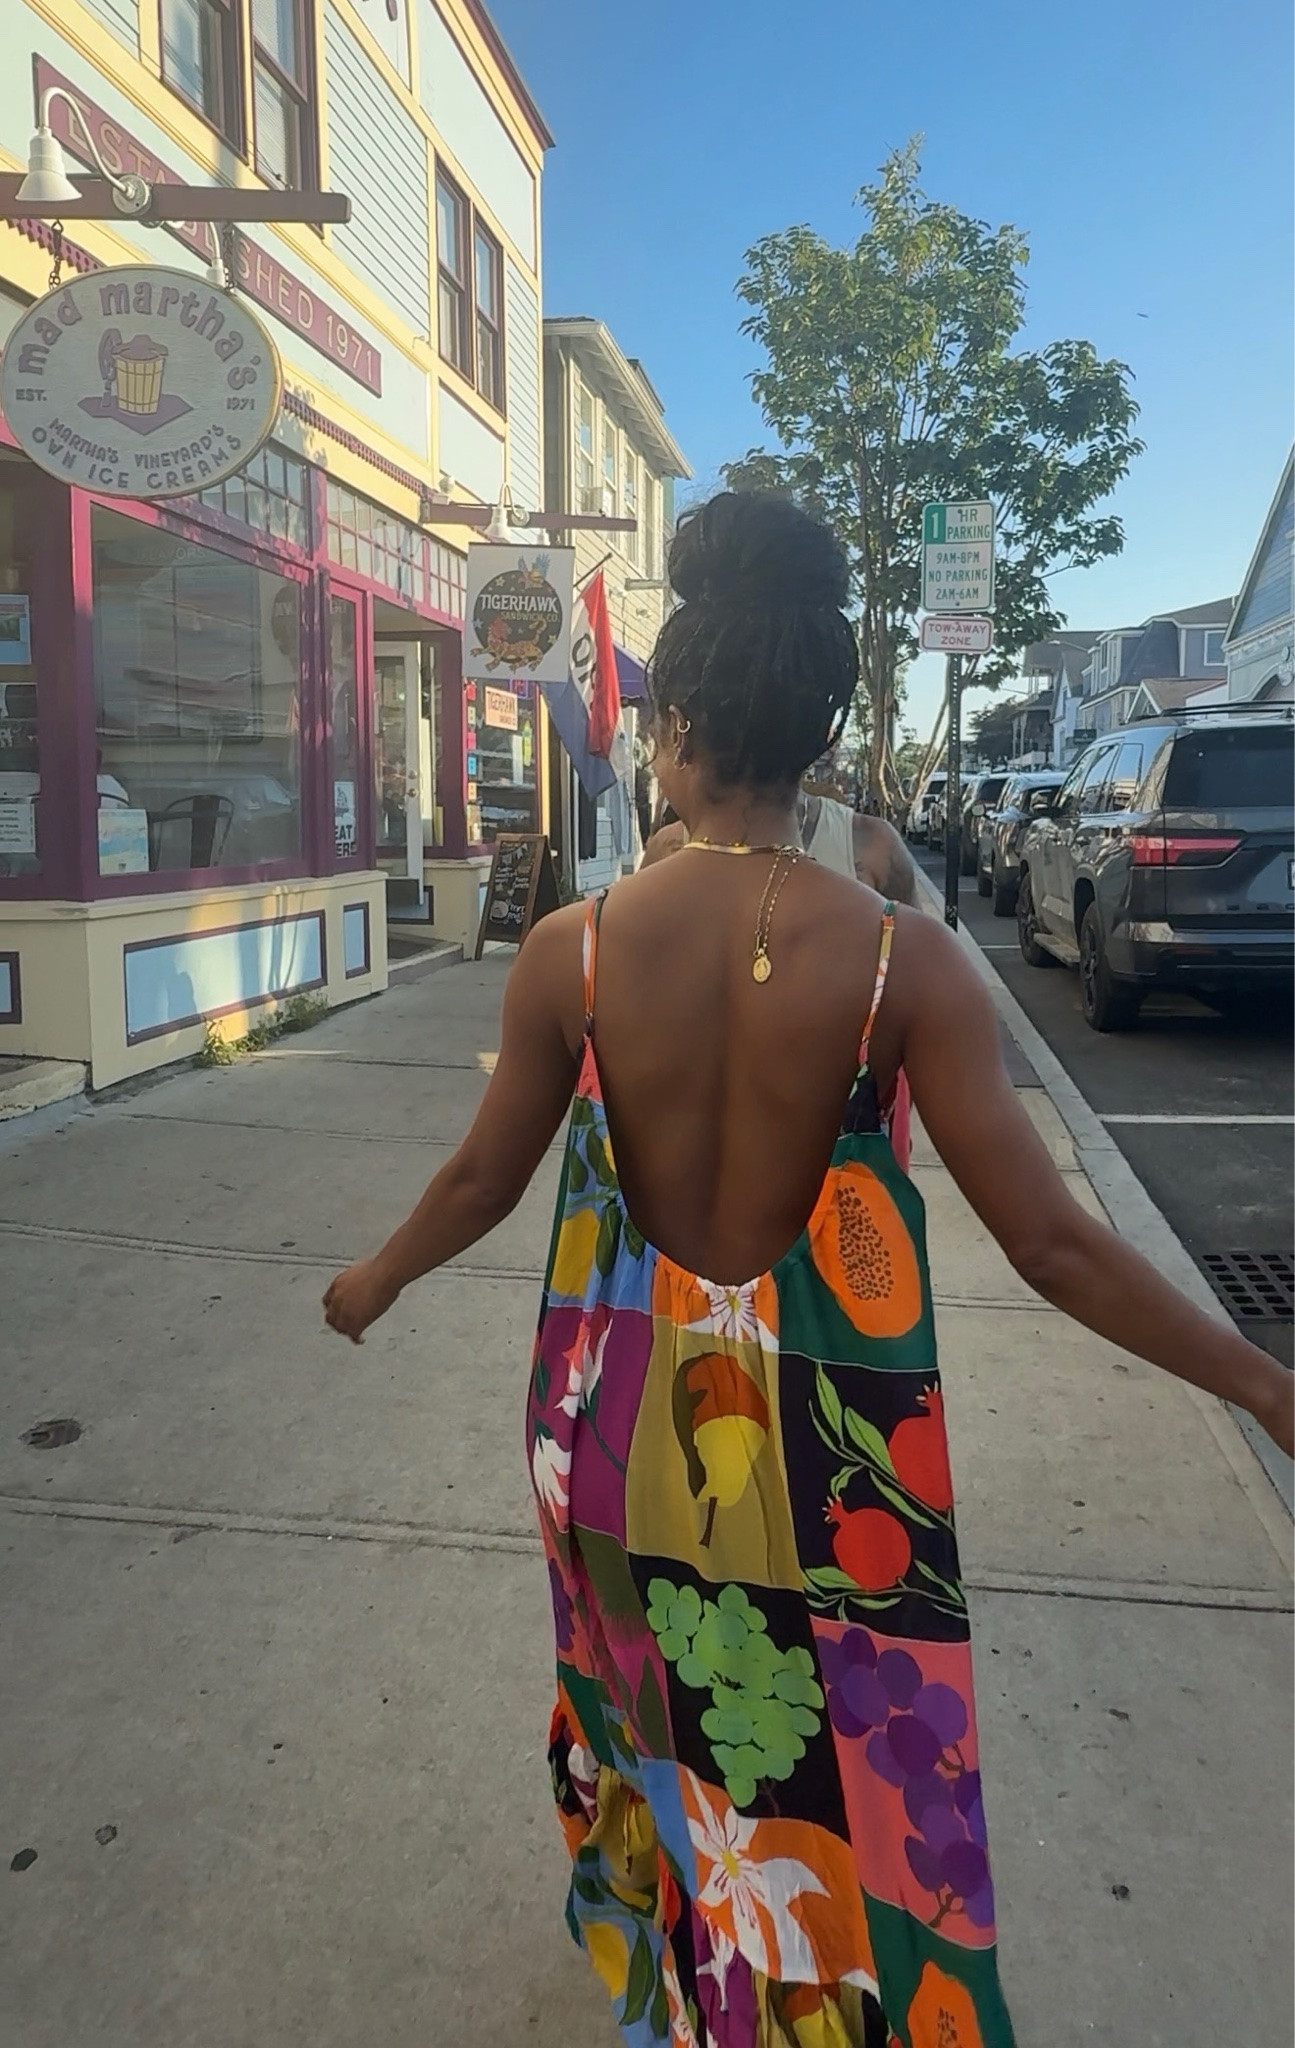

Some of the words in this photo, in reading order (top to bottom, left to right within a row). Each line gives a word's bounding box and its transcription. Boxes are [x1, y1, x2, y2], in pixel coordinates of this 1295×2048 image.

[18, 288, 82, 376] mad
[99, 281, 261, 391] martha's
[326, 314, 374, 383] 1971
[15, 388, 48, 402] EST.
[226, 396, 256, 411] 1971
[49, 418, 119, 464] MARTHA'S
[134, 424, 225, 469] VINEYARD'S
[32, 426, 76, 469] OWN
[88, 464, 130, 488] ICE
[147, 434, 241, 489] CREAMS
[931, 512, 939, 539] 1
[960, 508, 978, 523] HR
[947, 525, 990, 540] PARKING
[936, 552, 980, 565] 9AM-8PM
[928, 570, 942, 583] NO
[945, 568, 988, 582] PARKING
[936, 587, 979, 600] 2AM-6AM
[479, 594, 559, 613] TIGERHAWK
[928, 623, 987, 635] TOW-AWAY
[941, 636, 971, 646] ZONE
